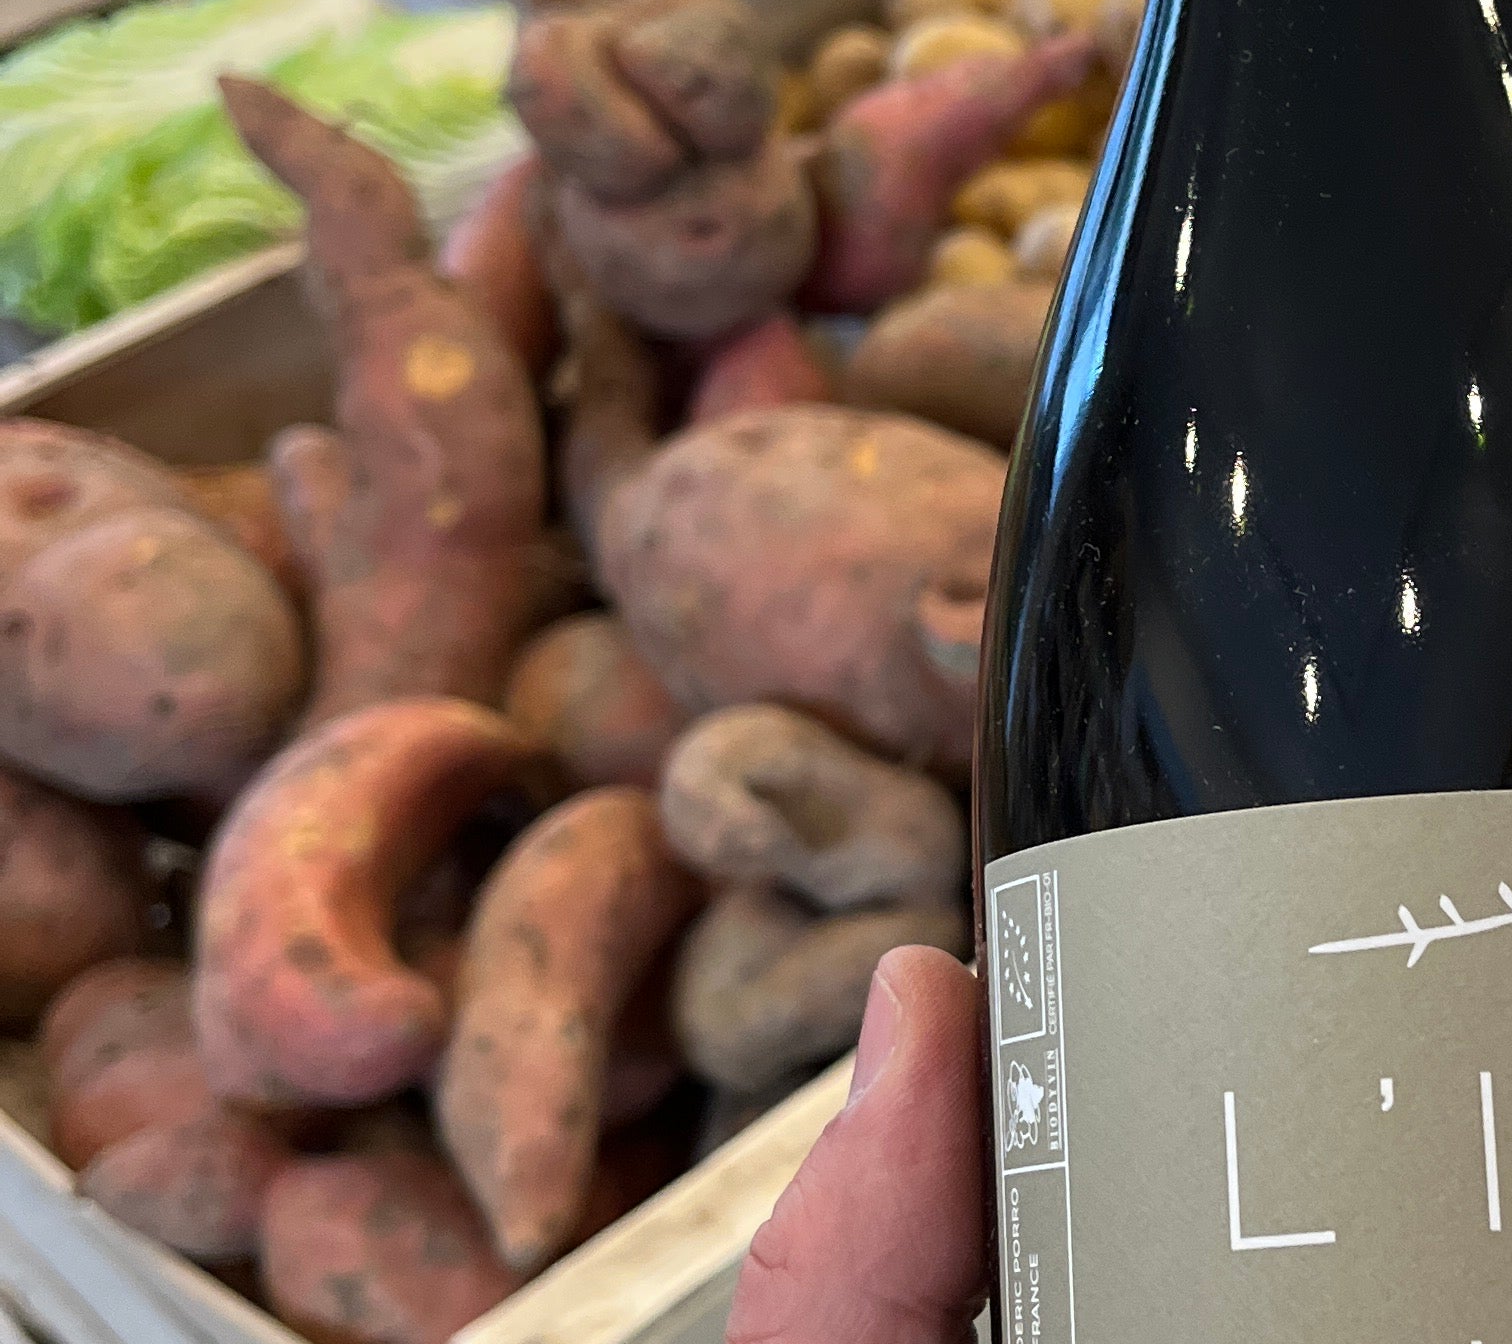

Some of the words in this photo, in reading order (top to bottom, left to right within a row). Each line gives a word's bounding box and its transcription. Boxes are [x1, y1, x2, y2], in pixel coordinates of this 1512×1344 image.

[1044, 943, 1054, 970] PAR
[1045, 974, 1058, 1035] CERTIFIÉ
[1046, 1049, 1059, 1150] BIODYVIN
[1010, 1187, 1021, 1273] PORRO
